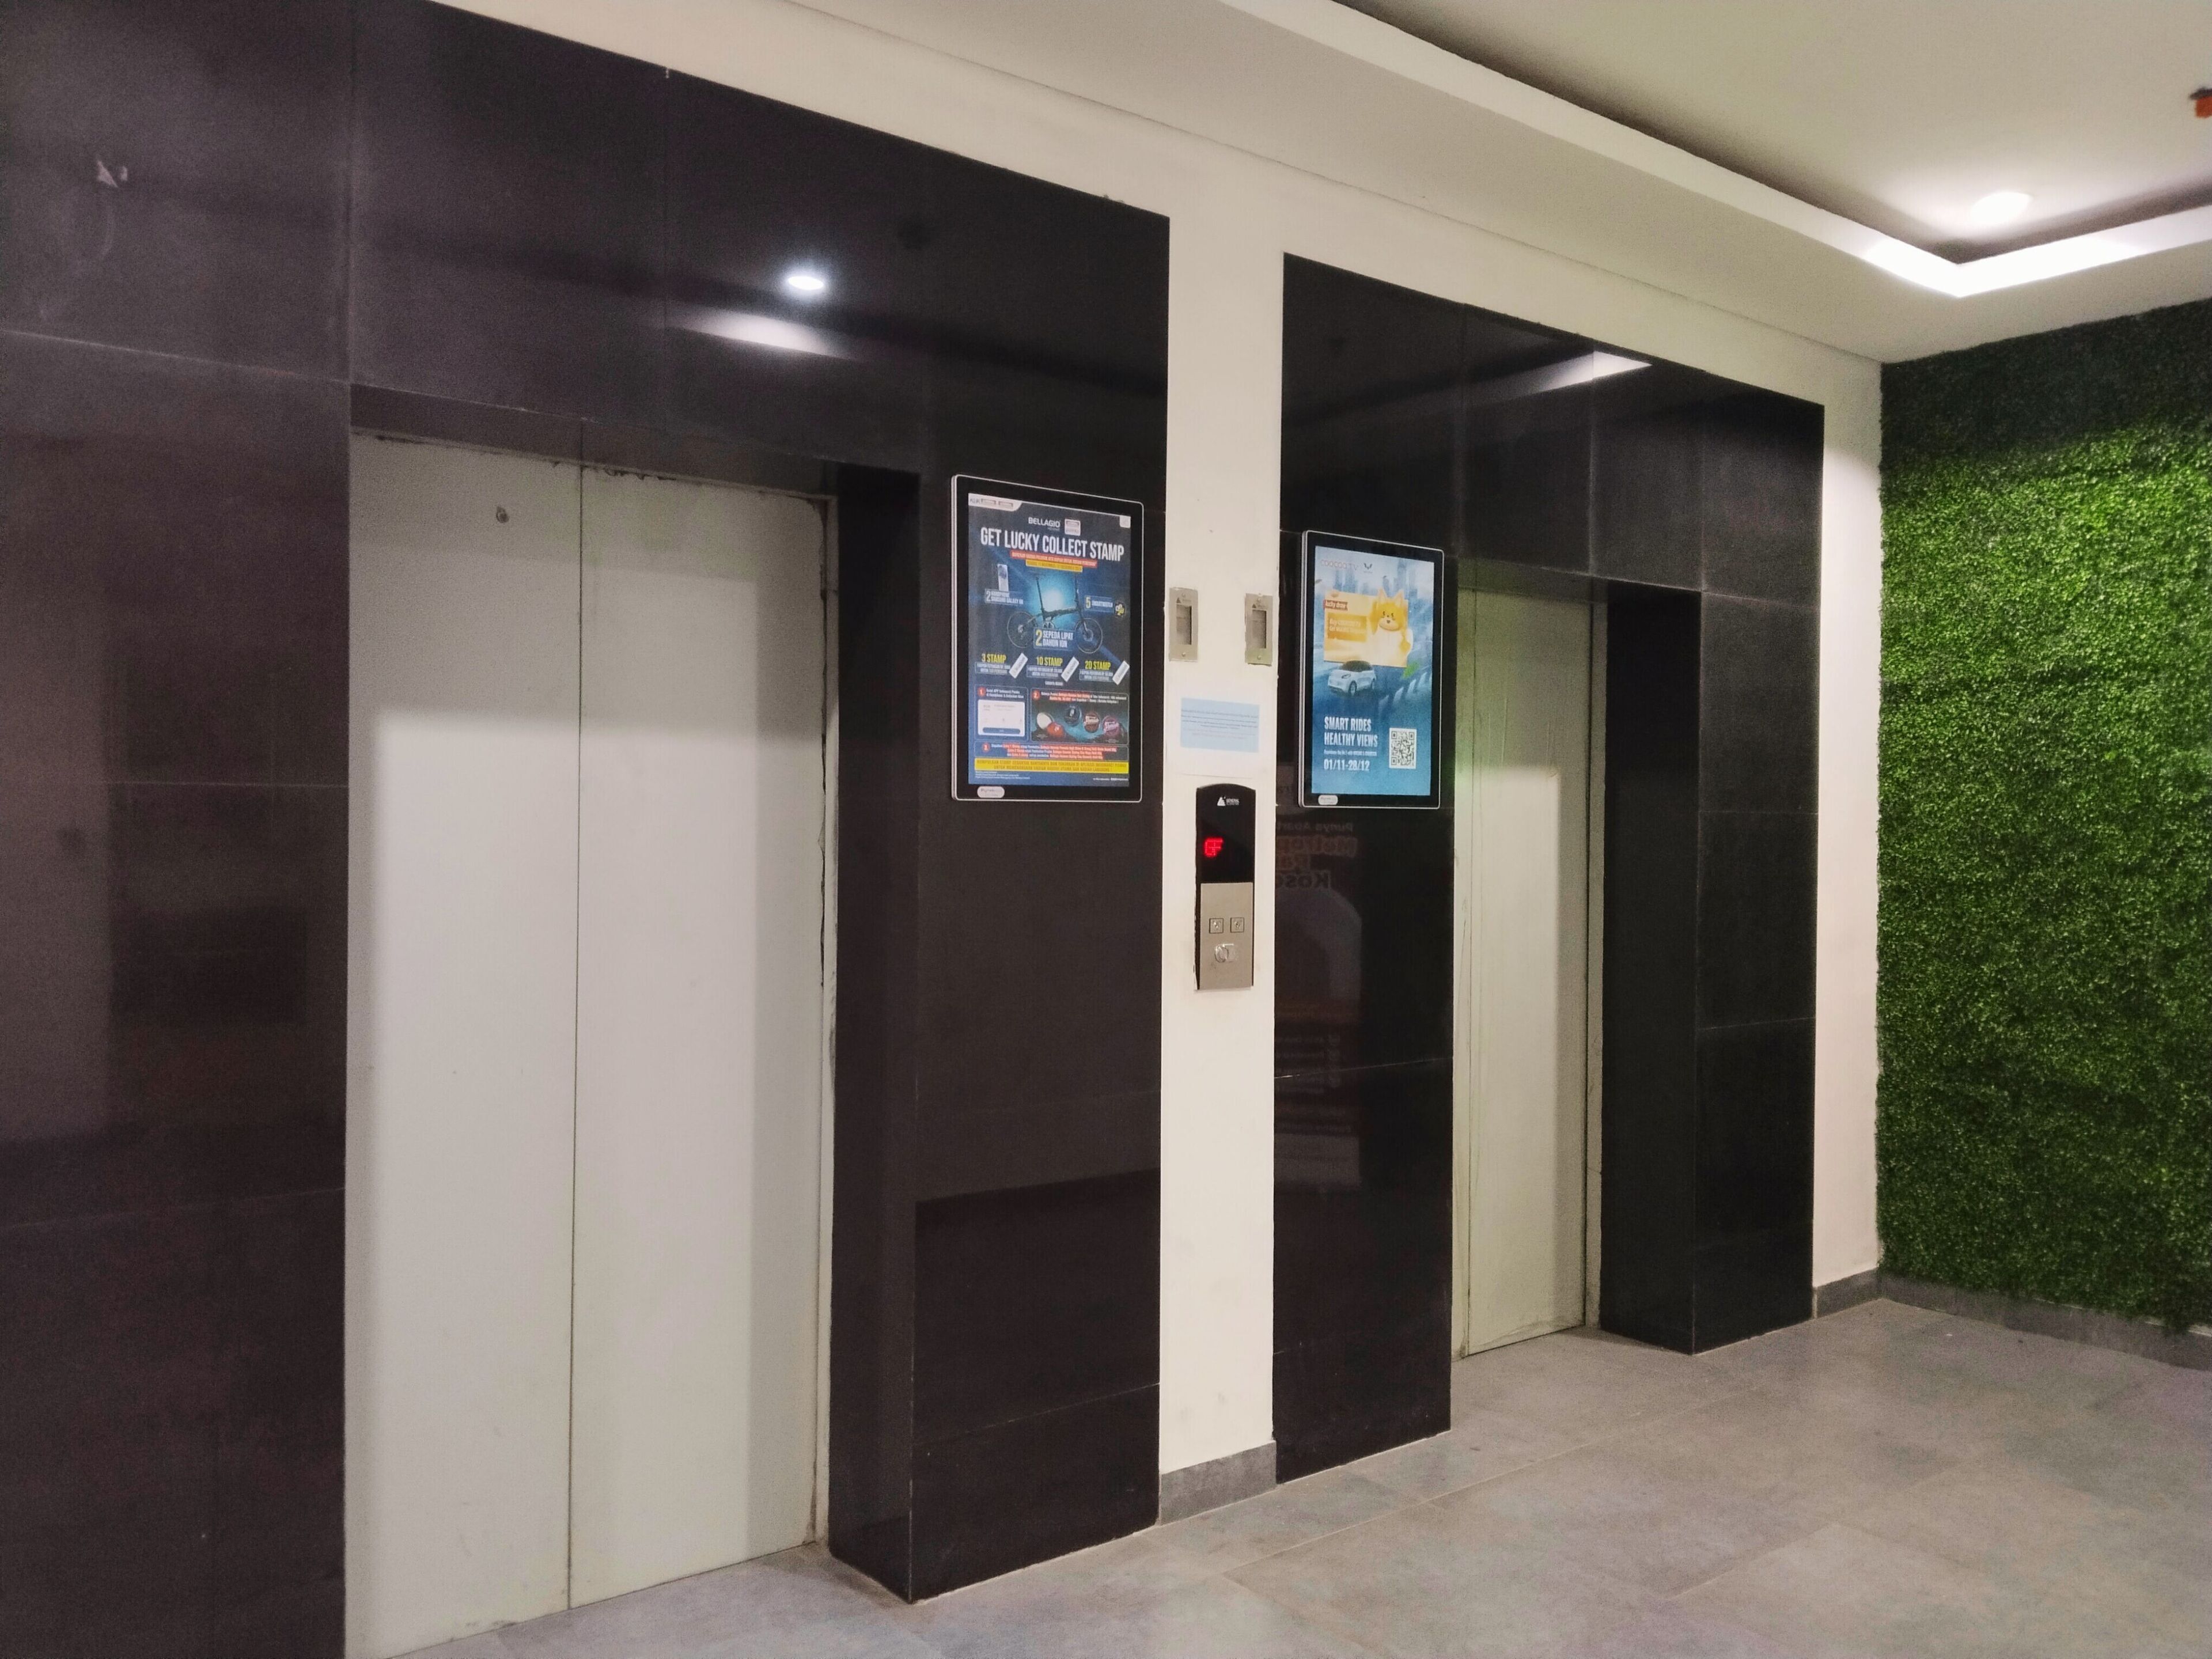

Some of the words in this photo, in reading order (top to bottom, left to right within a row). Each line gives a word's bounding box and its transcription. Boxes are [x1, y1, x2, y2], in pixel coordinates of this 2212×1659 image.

[1028, 517, 1060, 528] BELLAGIO
[980, 527, 1002, 546] GET
[1004, 530, 1040, 551] LUCKY
[1042, 535, 1088, 557] COLLECT
[1090, 541, 1125, 562] STAMP
[986, 590, 991, 601] 2
[1086, 597, 1091, 608] 5
[1036, 629, 1042, 646] 2
[1043, 630, 1060, 639] SEPEDA
[1061, 631, 1073, 641] LIPAT
[982, 653, 986, 662] 3
[987, 654, 1006, 664] STAMP
[1036, 657, 1043, 665] 10
[1044, 657, 1063, 666] STAMP
[1085, 660, 1093, 669] 20
[1093, 661, 1111, 671] STAMP
[1324, 716, 1349, 730] SMART
[1350, 718, 1372, 732] RIDES
[1324, 732, 1355, 746] HEALTHY
[1357, 734, 1378, 747] VIEWS
